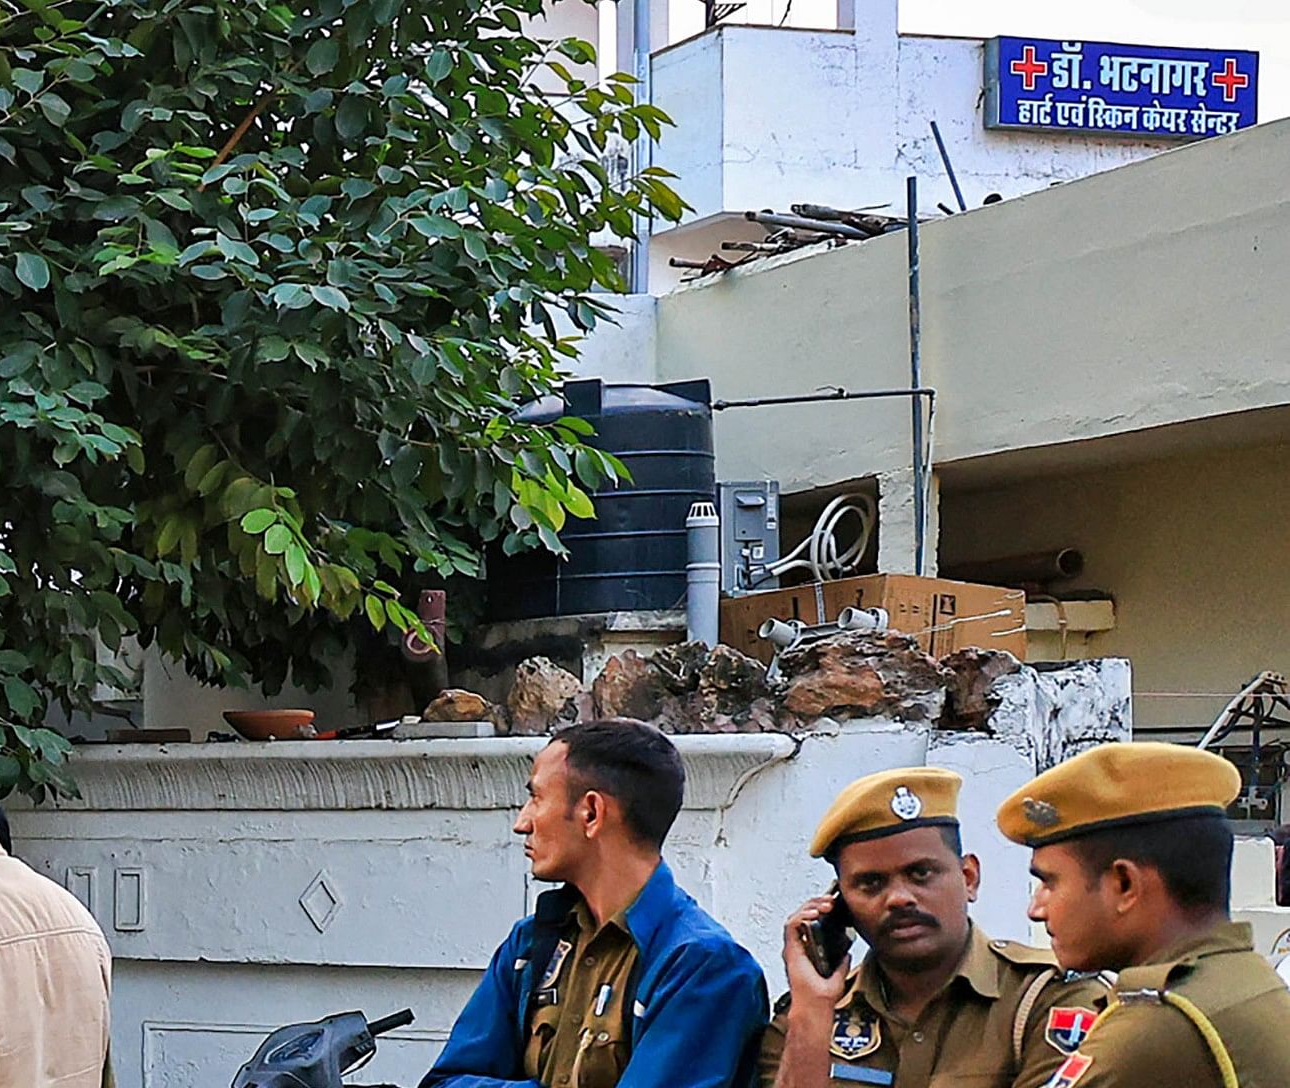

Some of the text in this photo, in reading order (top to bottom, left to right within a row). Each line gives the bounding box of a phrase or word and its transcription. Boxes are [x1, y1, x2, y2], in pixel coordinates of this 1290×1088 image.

[1051, 42, 1209, 96] डॉ. भटनागर
[1017, 93, 1239, 134] हार्ट एवं स्किन केयर सेन्टर
